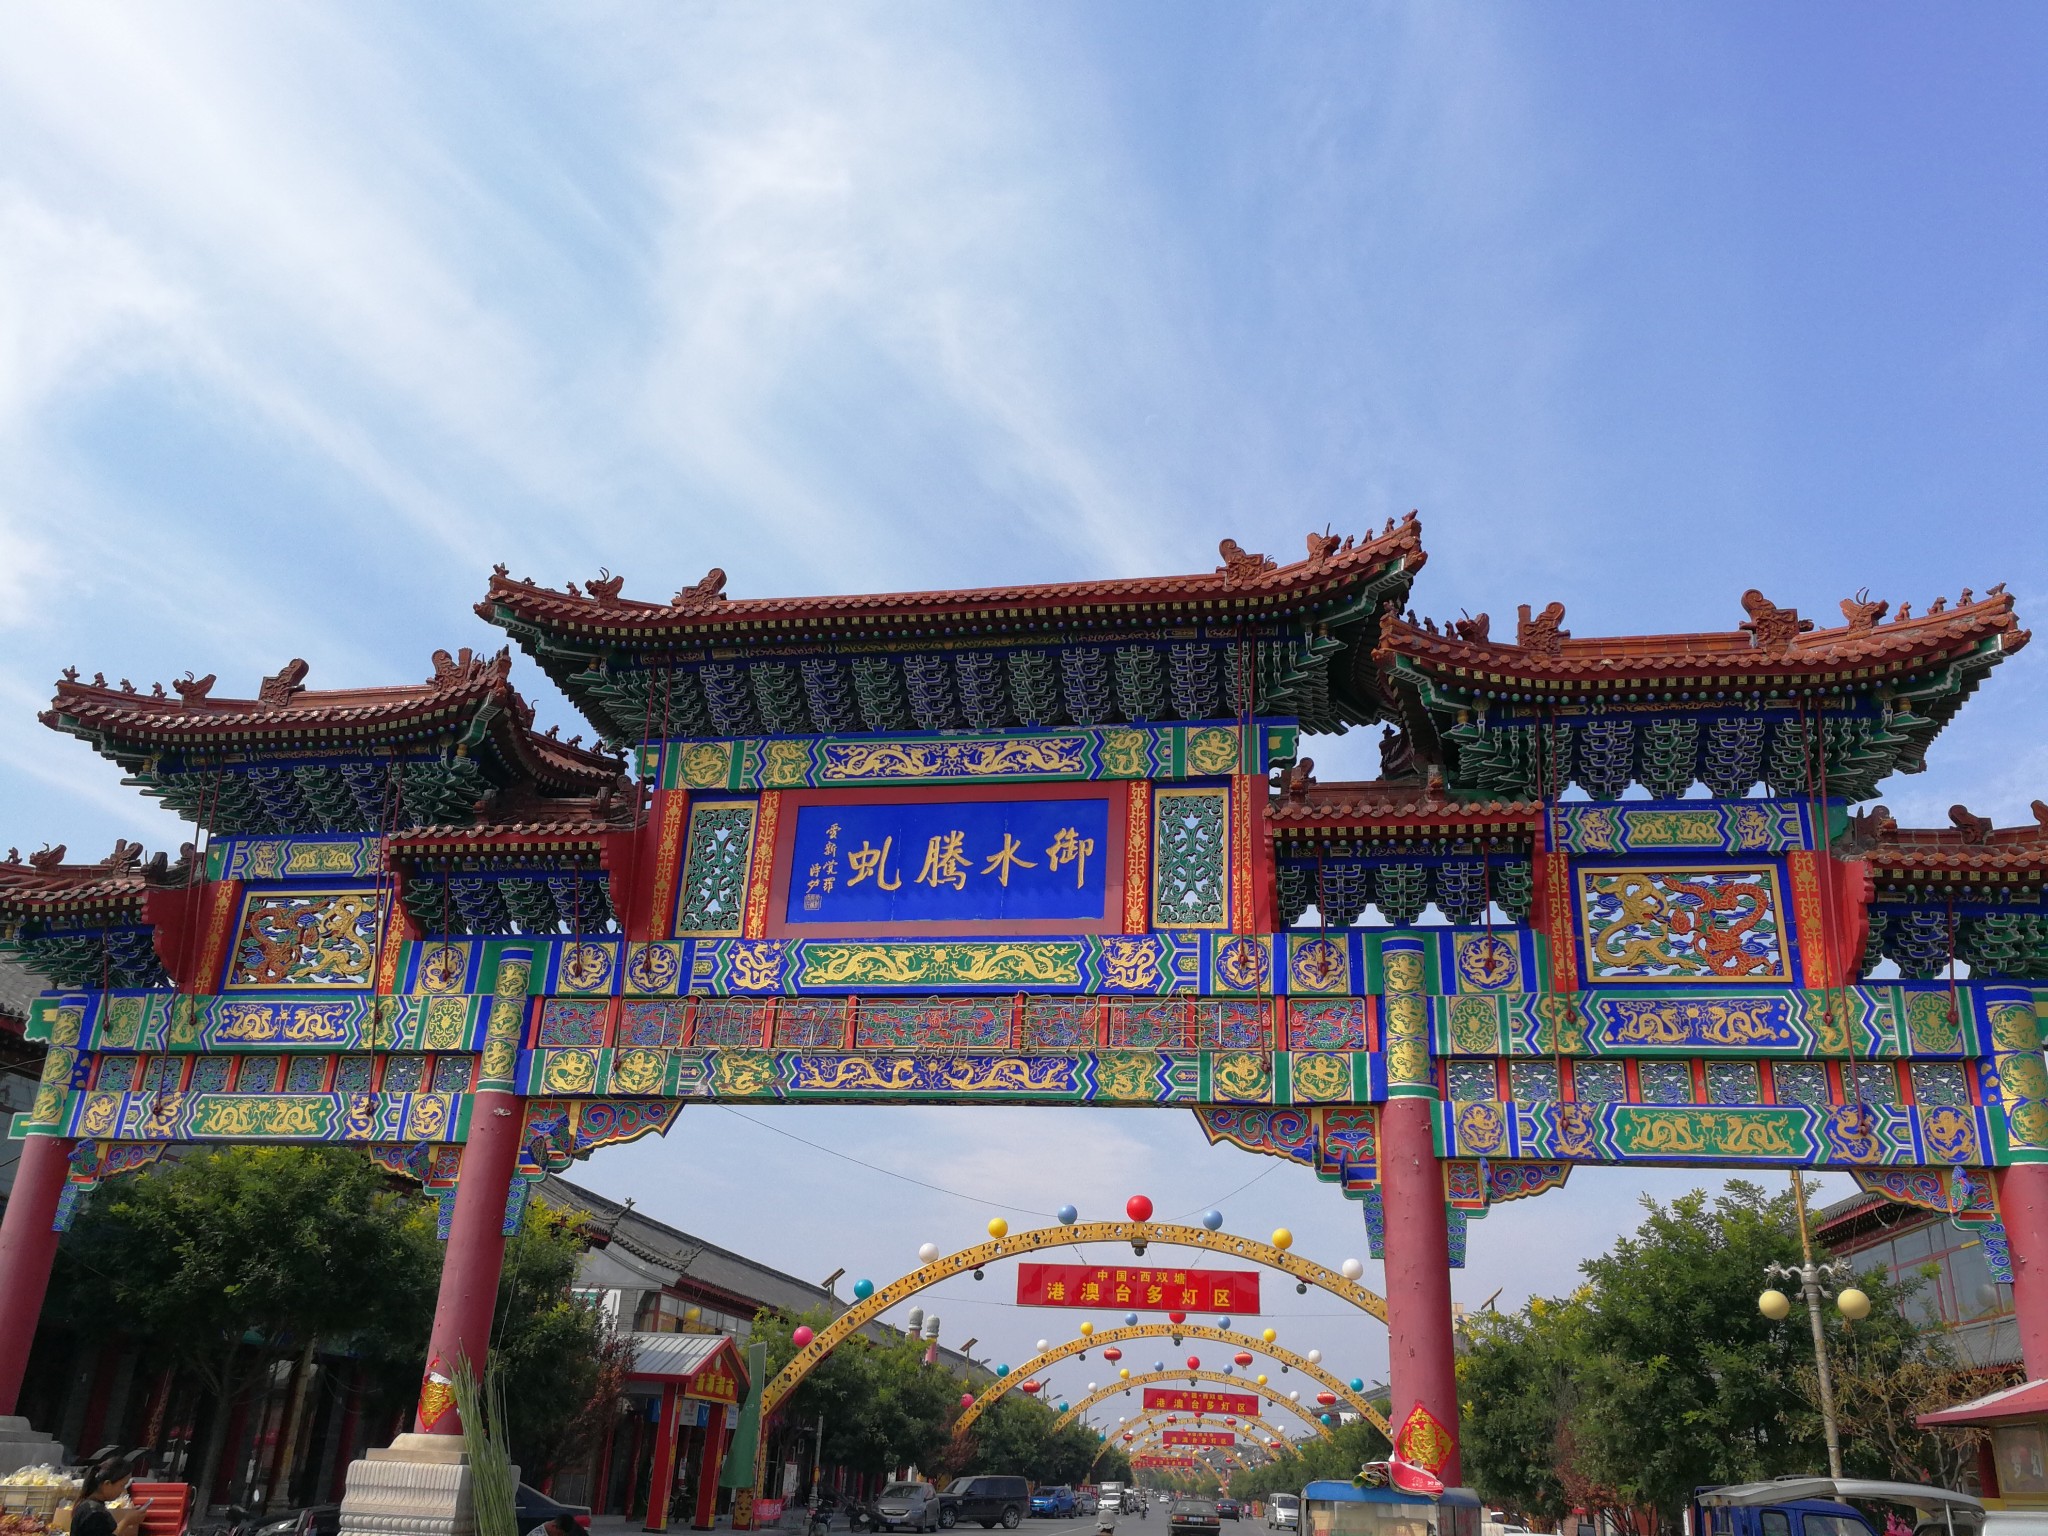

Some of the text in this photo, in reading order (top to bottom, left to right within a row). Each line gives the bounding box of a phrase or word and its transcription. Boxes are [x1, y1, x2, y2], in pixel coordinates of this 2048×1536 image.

[1047, 1281, 1231, 1307] 港澳台多灯区
